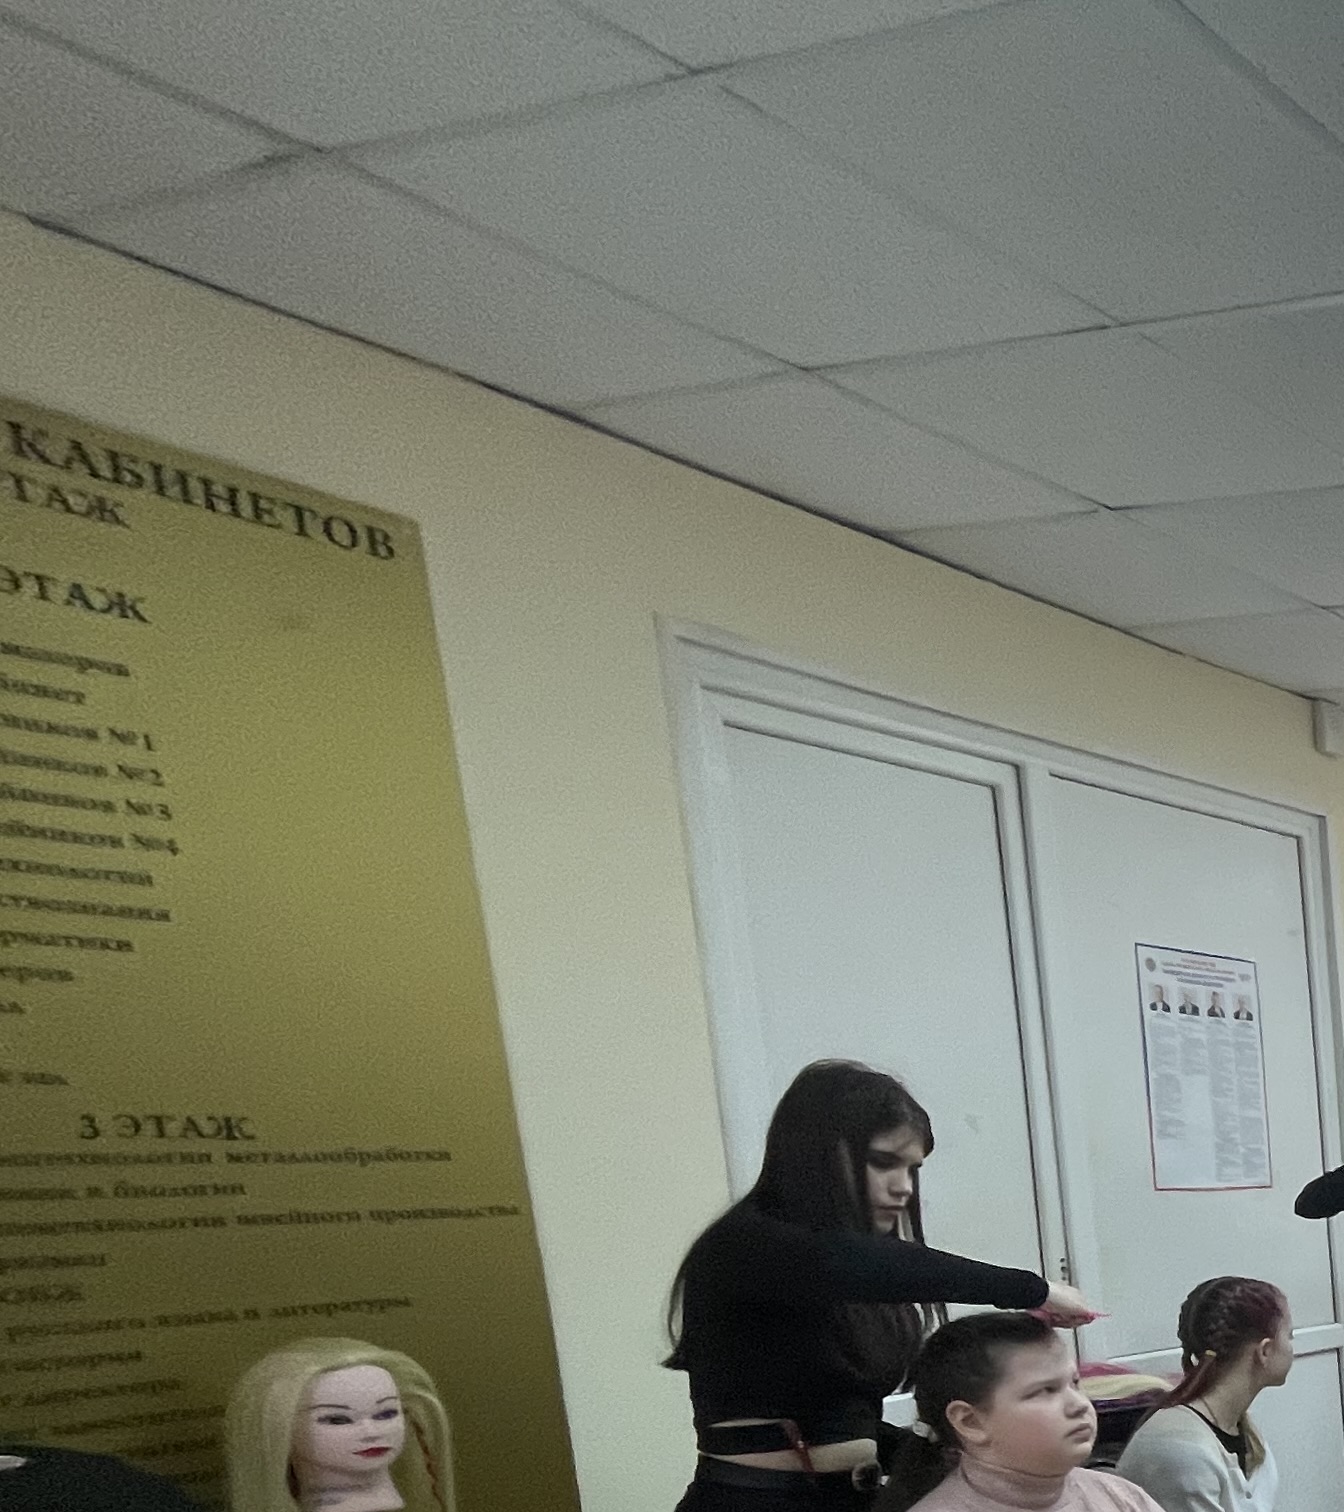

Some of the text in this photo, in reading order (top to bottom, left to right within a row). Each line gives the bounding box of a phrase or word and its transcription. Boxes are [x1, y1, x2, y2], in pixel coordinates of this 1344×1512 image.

[2, 469, 132, 530] ТАЖ
[5, 420, 397, 561] КАБИНЕТОВ
[78, 1112, 257, 1141] 3 ЭТАЖ
